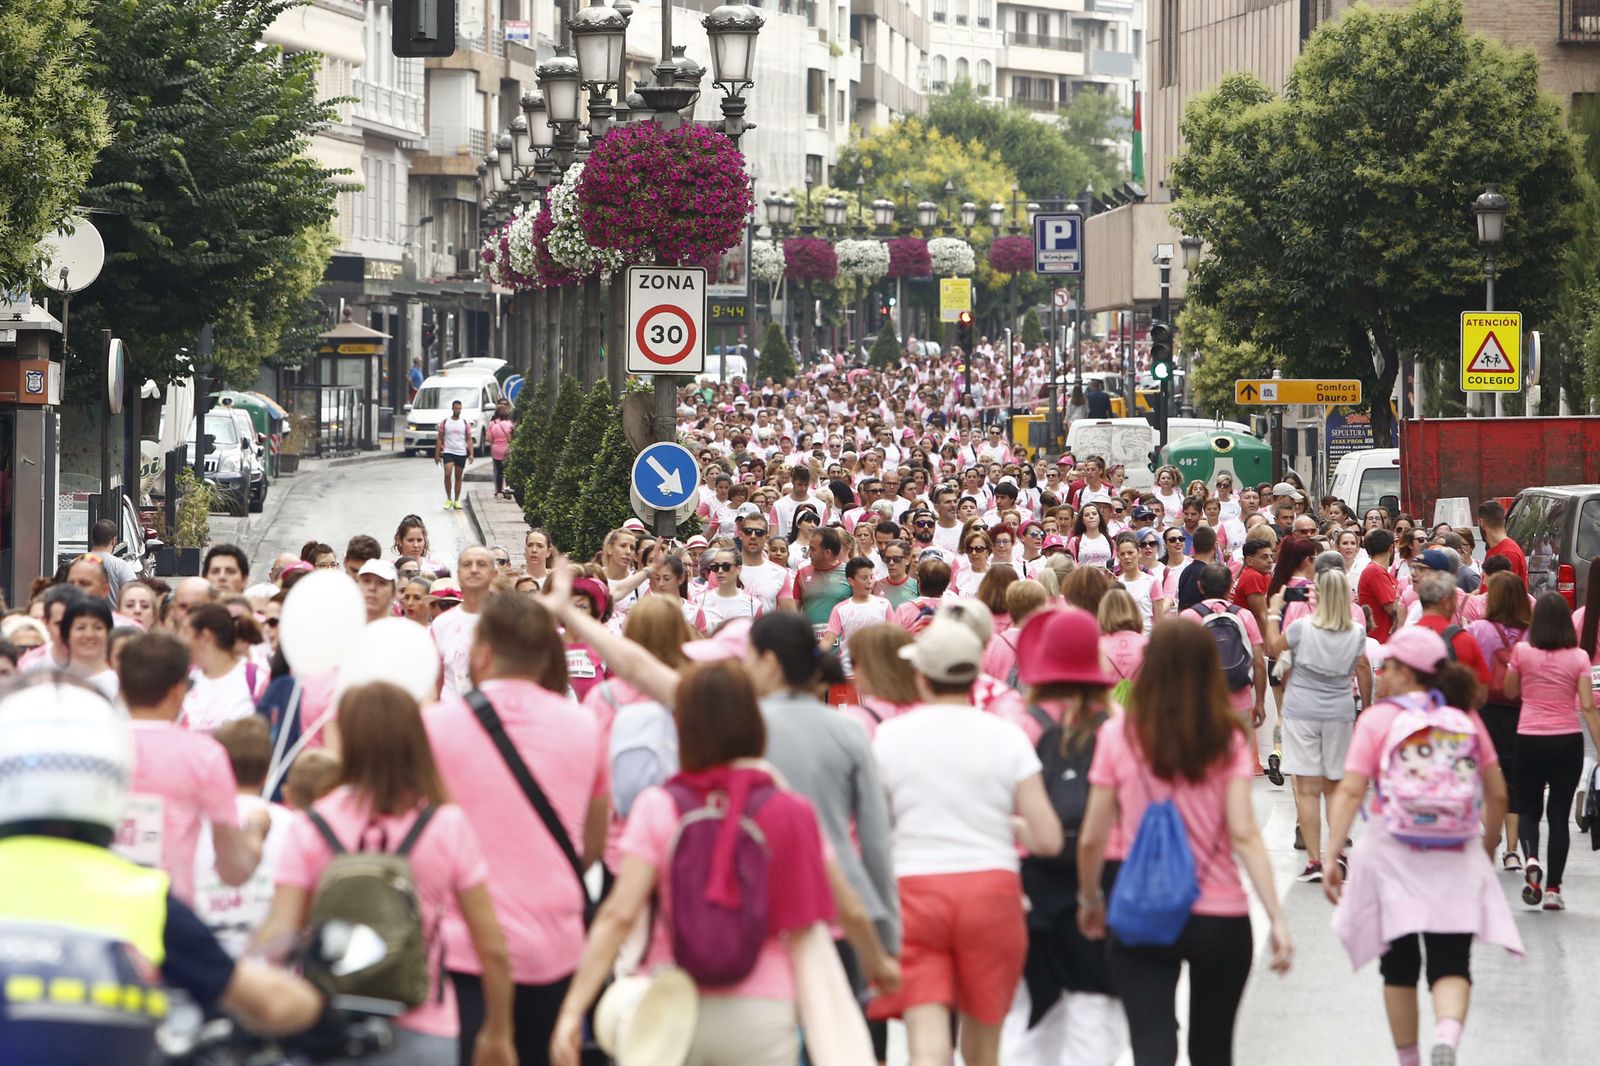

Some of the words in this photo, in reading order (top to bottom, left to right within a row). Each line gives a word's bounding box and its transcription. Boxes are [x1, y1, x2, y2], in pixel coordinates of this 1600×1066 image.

[1045, 220, 1072, 249] P
[639, 274, 695, 290] ZONA
[712, 305, 744, 317] 9:44
[650, 324, 683, 344] 30
[1467, 376, 1515, 384] COLEGIO
[1316, 383, 1356, 391] Comfort
[1317, 394, 1348, 402] Dauro
[1351, 394, 1357, 402] 2
[1331, 429, 1366, 437] SEPULTURA
[1179, 457, 1198, 466] 497
